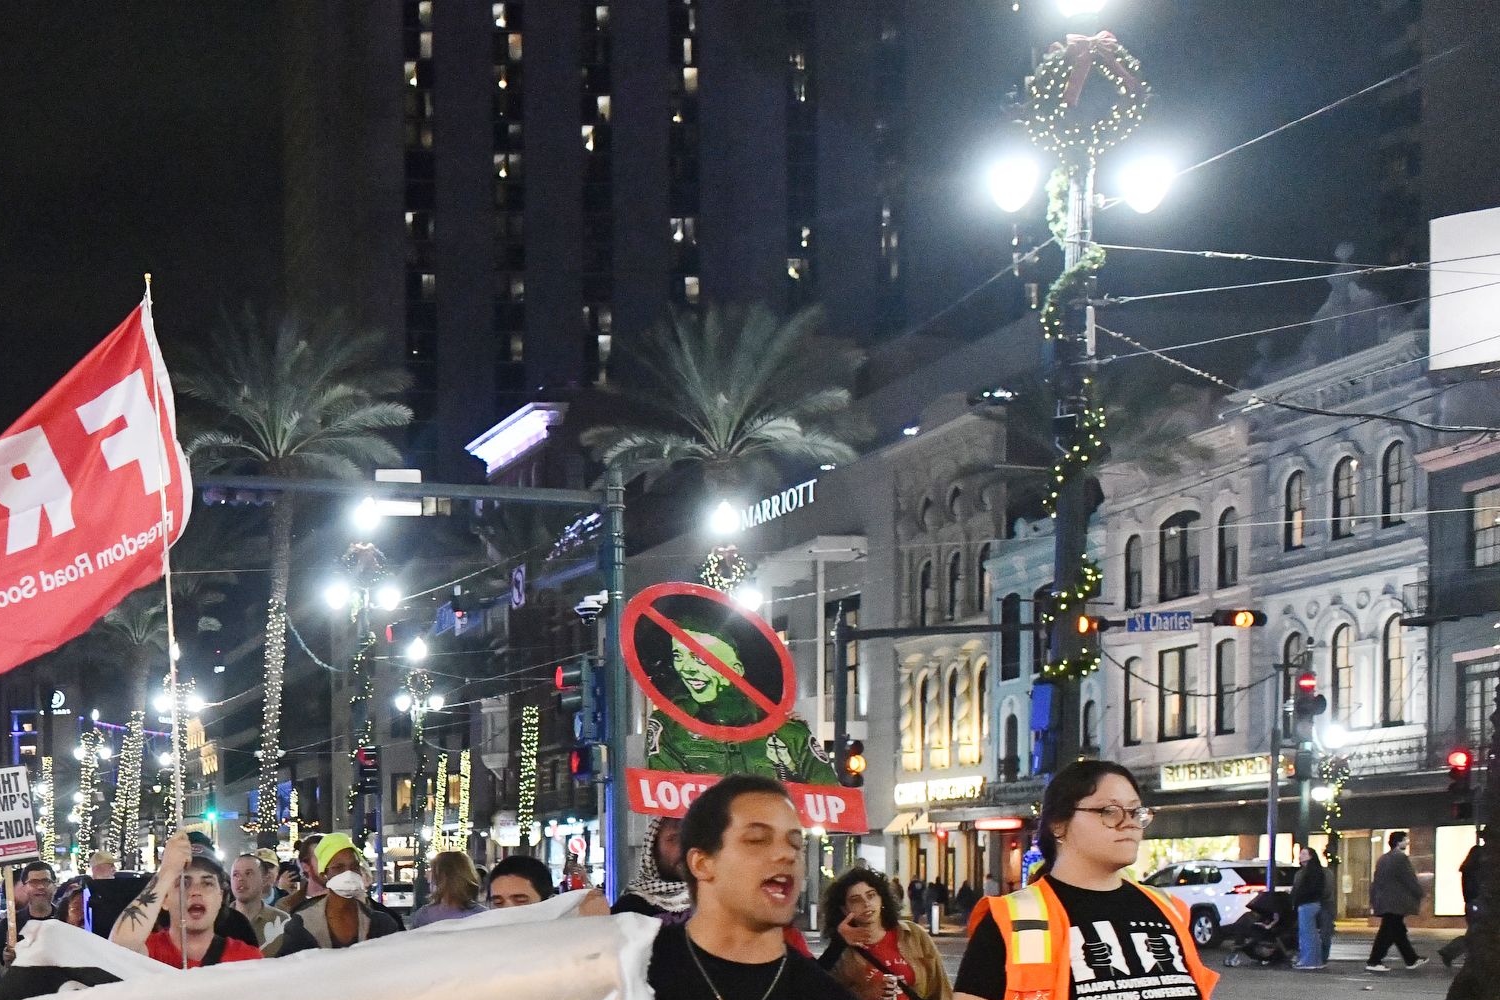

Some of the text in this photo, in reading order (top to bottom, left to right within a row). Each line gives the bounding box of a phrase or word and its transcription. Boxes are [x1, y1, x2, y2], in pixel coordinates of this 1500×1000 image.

[740, 478, 818, 531] MARRIOTT
[1135, 611, 1191, 632] St Charles
[639, 779, 846, 824] LOC UP
[1141, 986, 1198, 999] CONFERENCE
